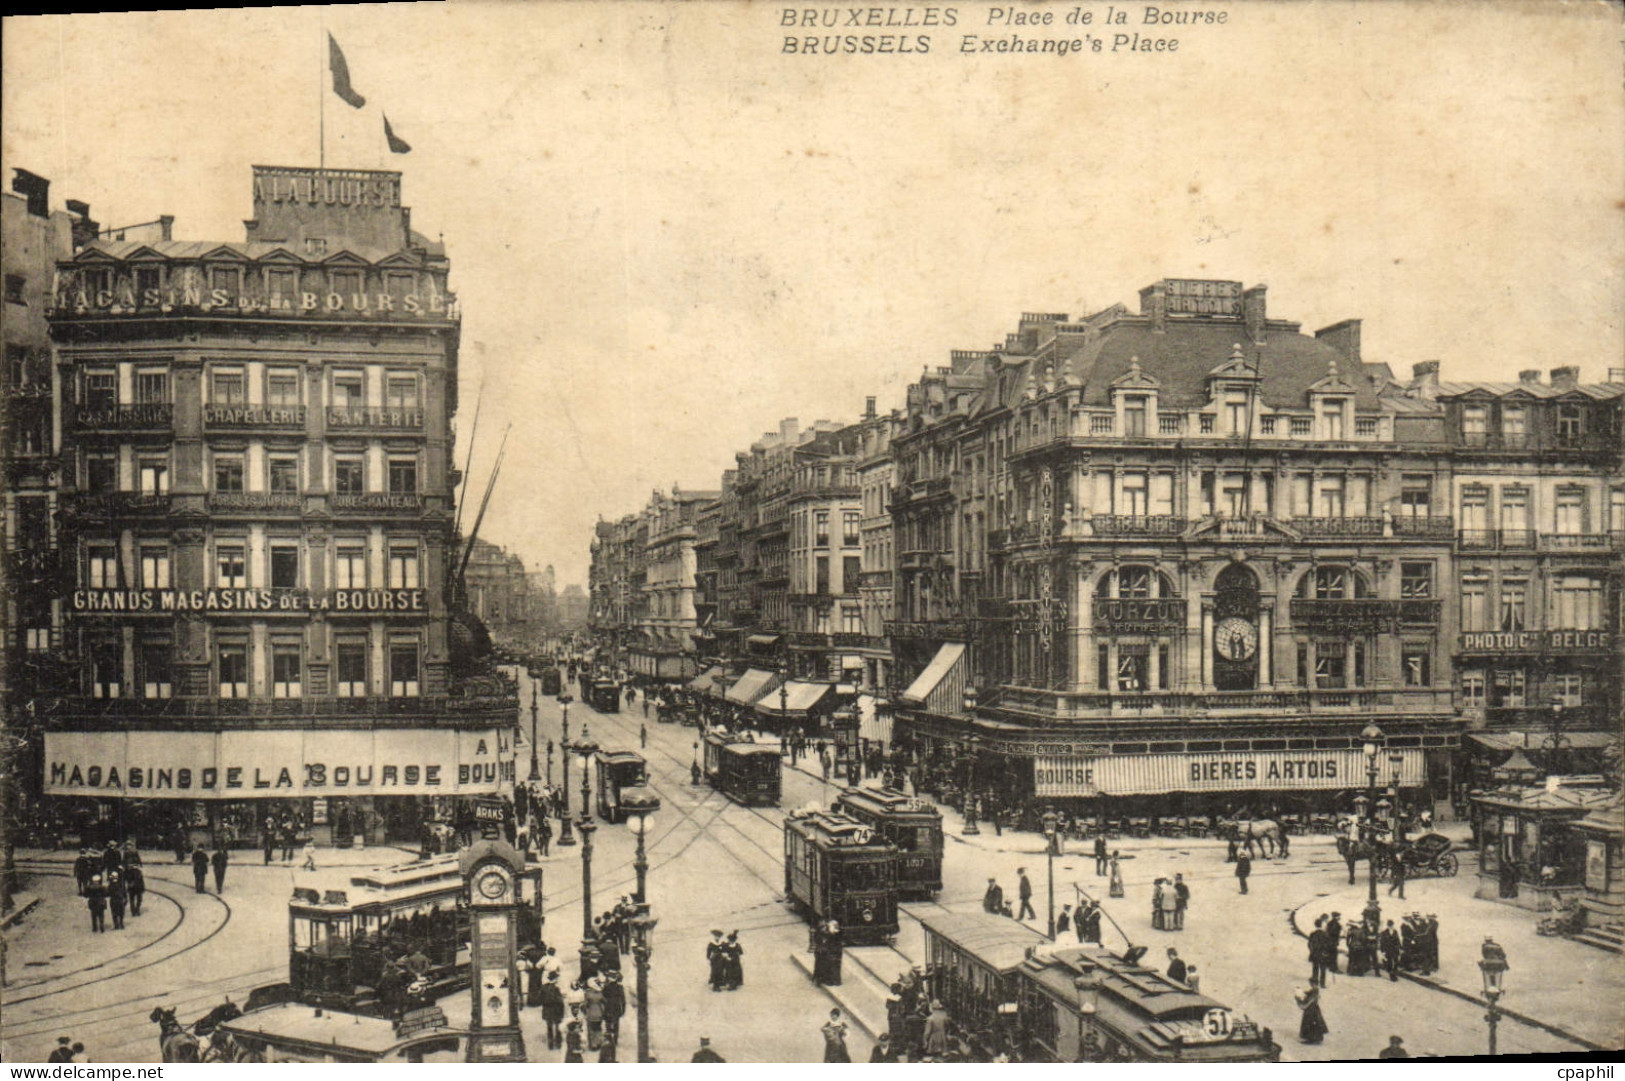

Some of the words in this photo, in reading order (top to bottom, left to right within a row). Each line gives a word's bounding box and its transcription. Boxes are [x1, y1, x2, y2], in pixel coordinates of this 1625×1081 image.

[302, 292, 445, 312] BOURSE
[204, 408, 304, 424] CHAPELLERIE
[327, 410, 422, 427] GANTERIE
[74, 591, 153, 609] GRANDS
[160, 590, 272, 609] MAGASINS
[280, 595, 302, 609] DE
[309, 597, 329, 609] LA
[335, 591, 424, 610] BOURSE
[1465, 634, 1514, 648] PHOTO
[1552, 632, 1609, 648] BELGE
[50, 761, 192, 789] MAGASINS
[201, 766, 243, 789] DE
[254, 766, 293, 788] LA
[303, 763, 442, 788] BOURSE
[1036, 768, 1093, 785] BOURSE
[1268, 760, 1337, 779] ARTOIS
[475, 806, 504, 821] ARAKS
[857, 828, 869, 843] 74
[1208, 1011, 1229, 1036] 51
